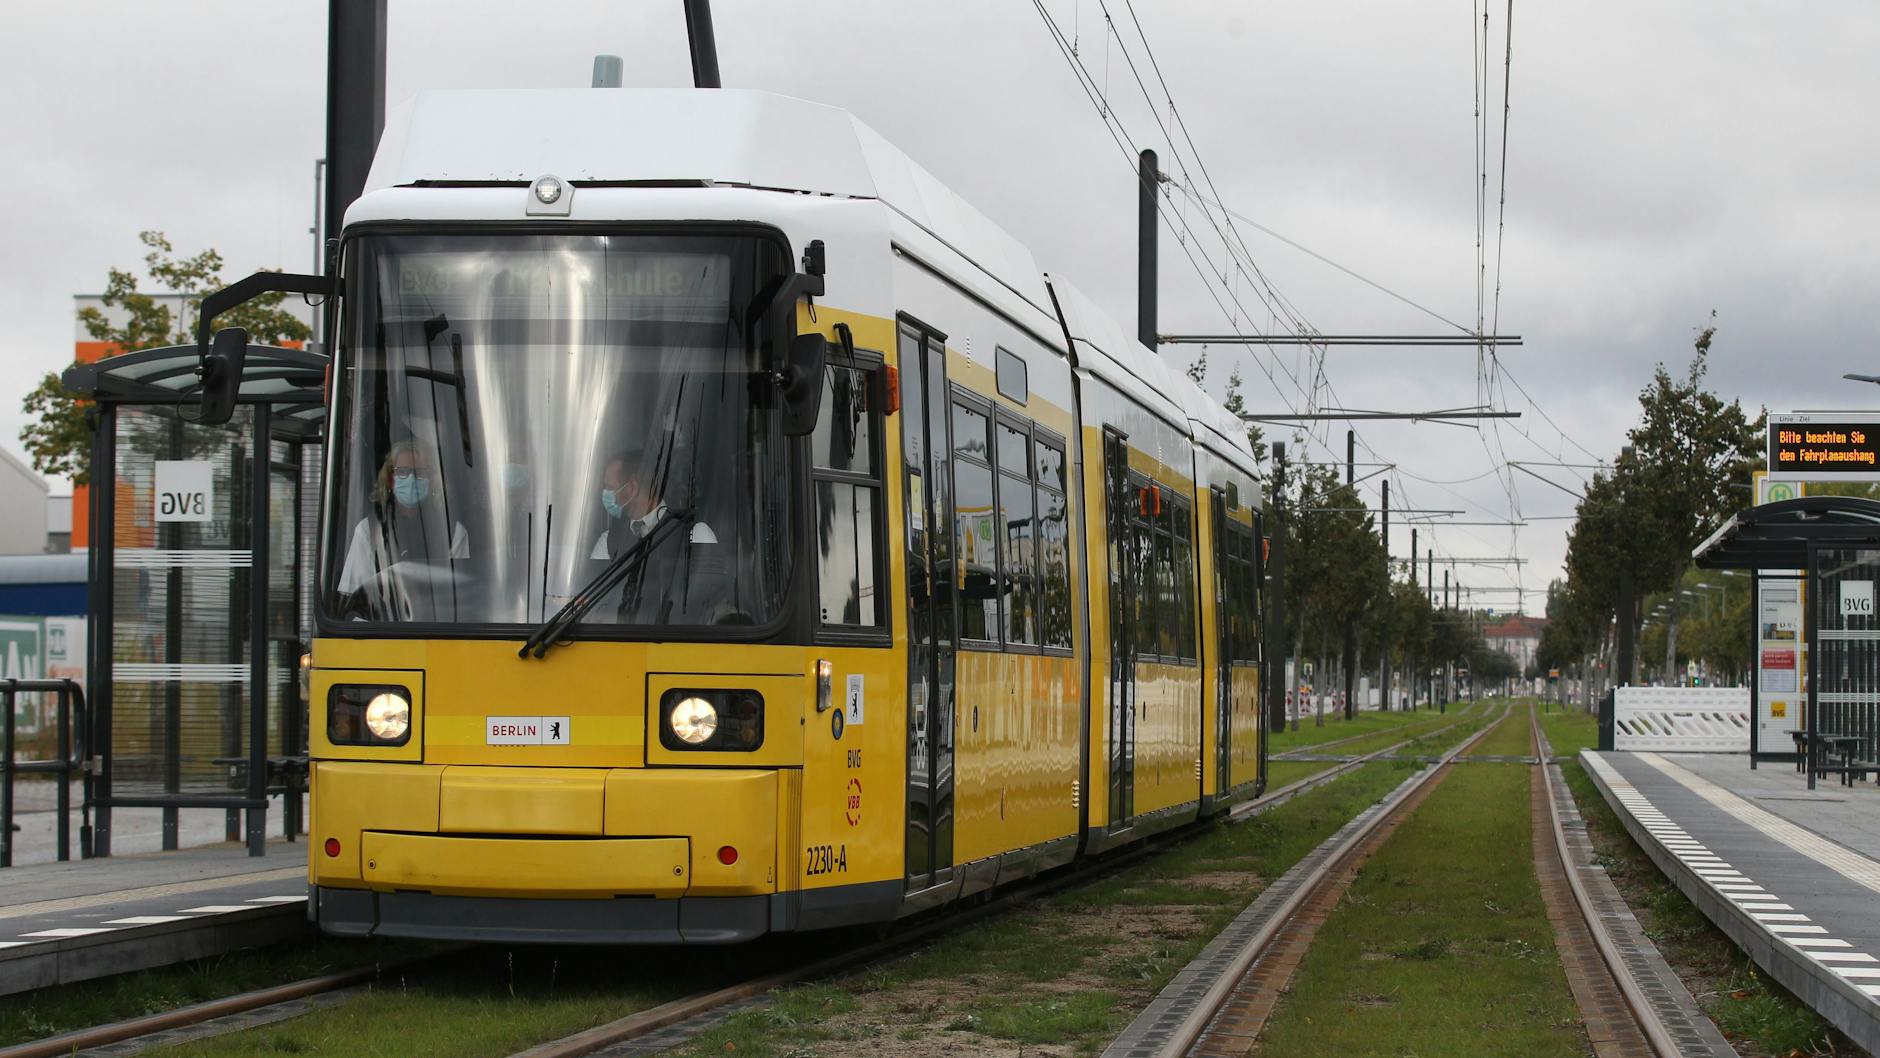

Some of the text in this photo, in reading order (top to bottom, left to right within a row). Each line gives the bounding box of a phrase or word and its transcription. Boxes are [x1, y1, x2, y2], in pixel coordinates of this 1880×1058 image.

[1779, 431, 1865, 444] Bitte beachten Sie
[1779, 449, 1875, 465] den Fahrplanaushang
[1844, 598, 1870, 611] BVG
[492, 725, 536, 736] BERLIN
[847, 749, 861, 768] BVG
[847, 795, 860, 809] VBB
[806, 844, 847, 876] 2230-A
